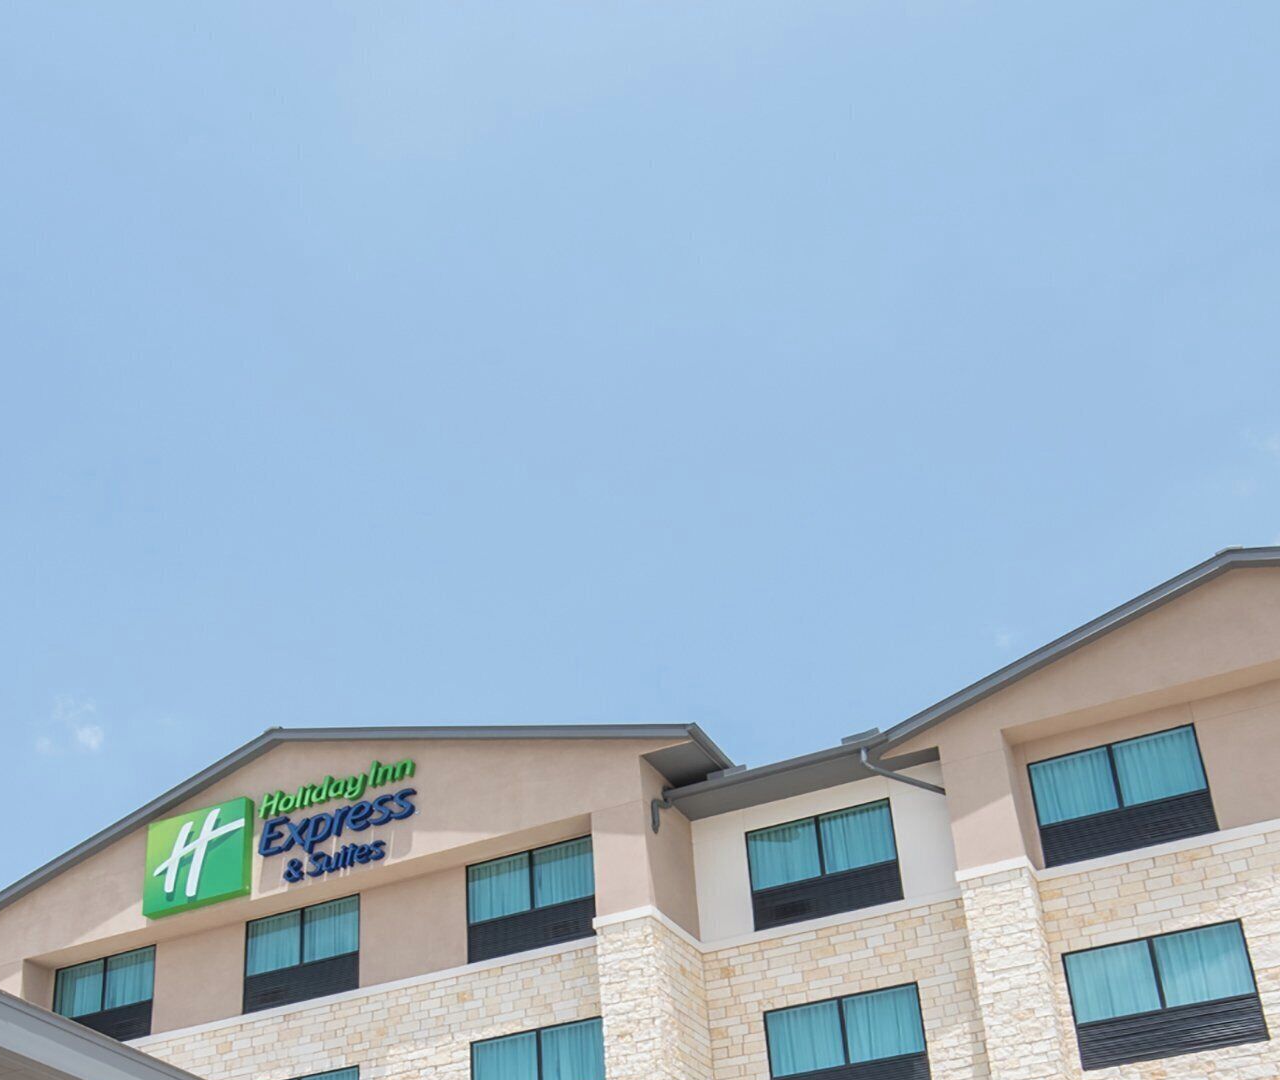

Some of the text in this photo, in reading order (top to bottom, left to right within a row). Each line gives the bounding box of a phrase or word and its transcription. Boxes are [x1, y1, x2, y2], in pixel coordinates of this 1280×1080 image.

[258, 758, 416, 819] Holiday Inn
[258, 788, 417, 857] Express
[283, 840, 386, 883] & Suites
